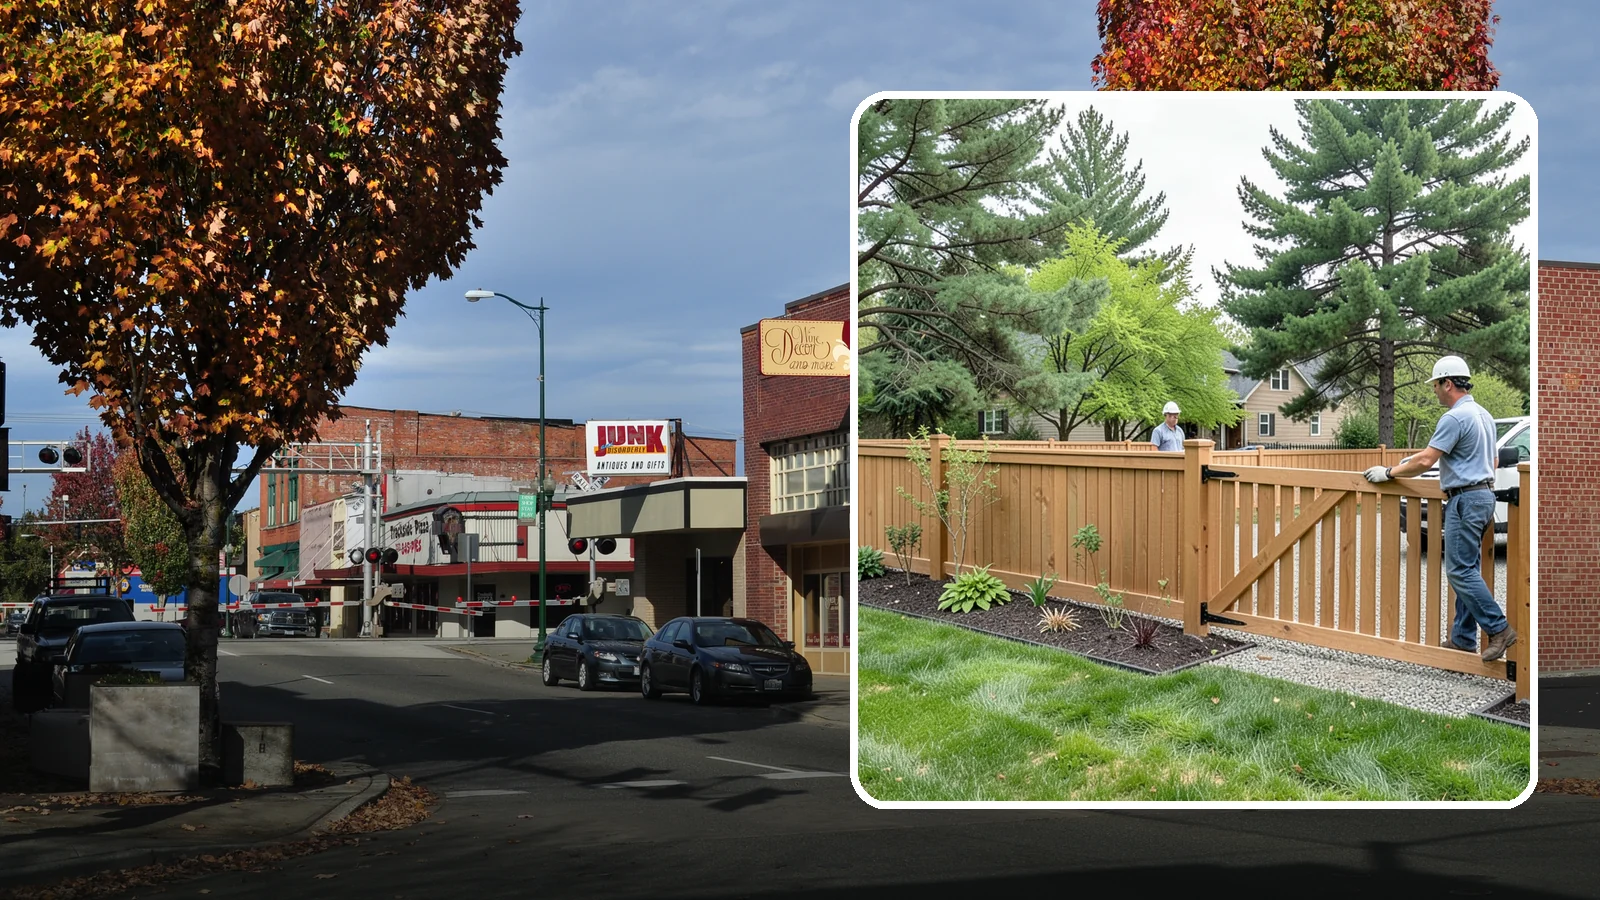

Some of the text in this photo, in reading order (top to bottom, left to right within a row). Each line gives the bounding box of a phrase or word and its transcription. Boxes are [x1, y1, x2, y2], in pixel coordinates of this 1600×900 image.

[765, 328, 831, 365] Decor
[595, 425, 664, 457] JUNK
[607, 445, 646, 454] DISORDERLY
[597, 460, 665, 470] ANTIQUES AND GIFTS
[415, 519, 429, 535] Pizza
